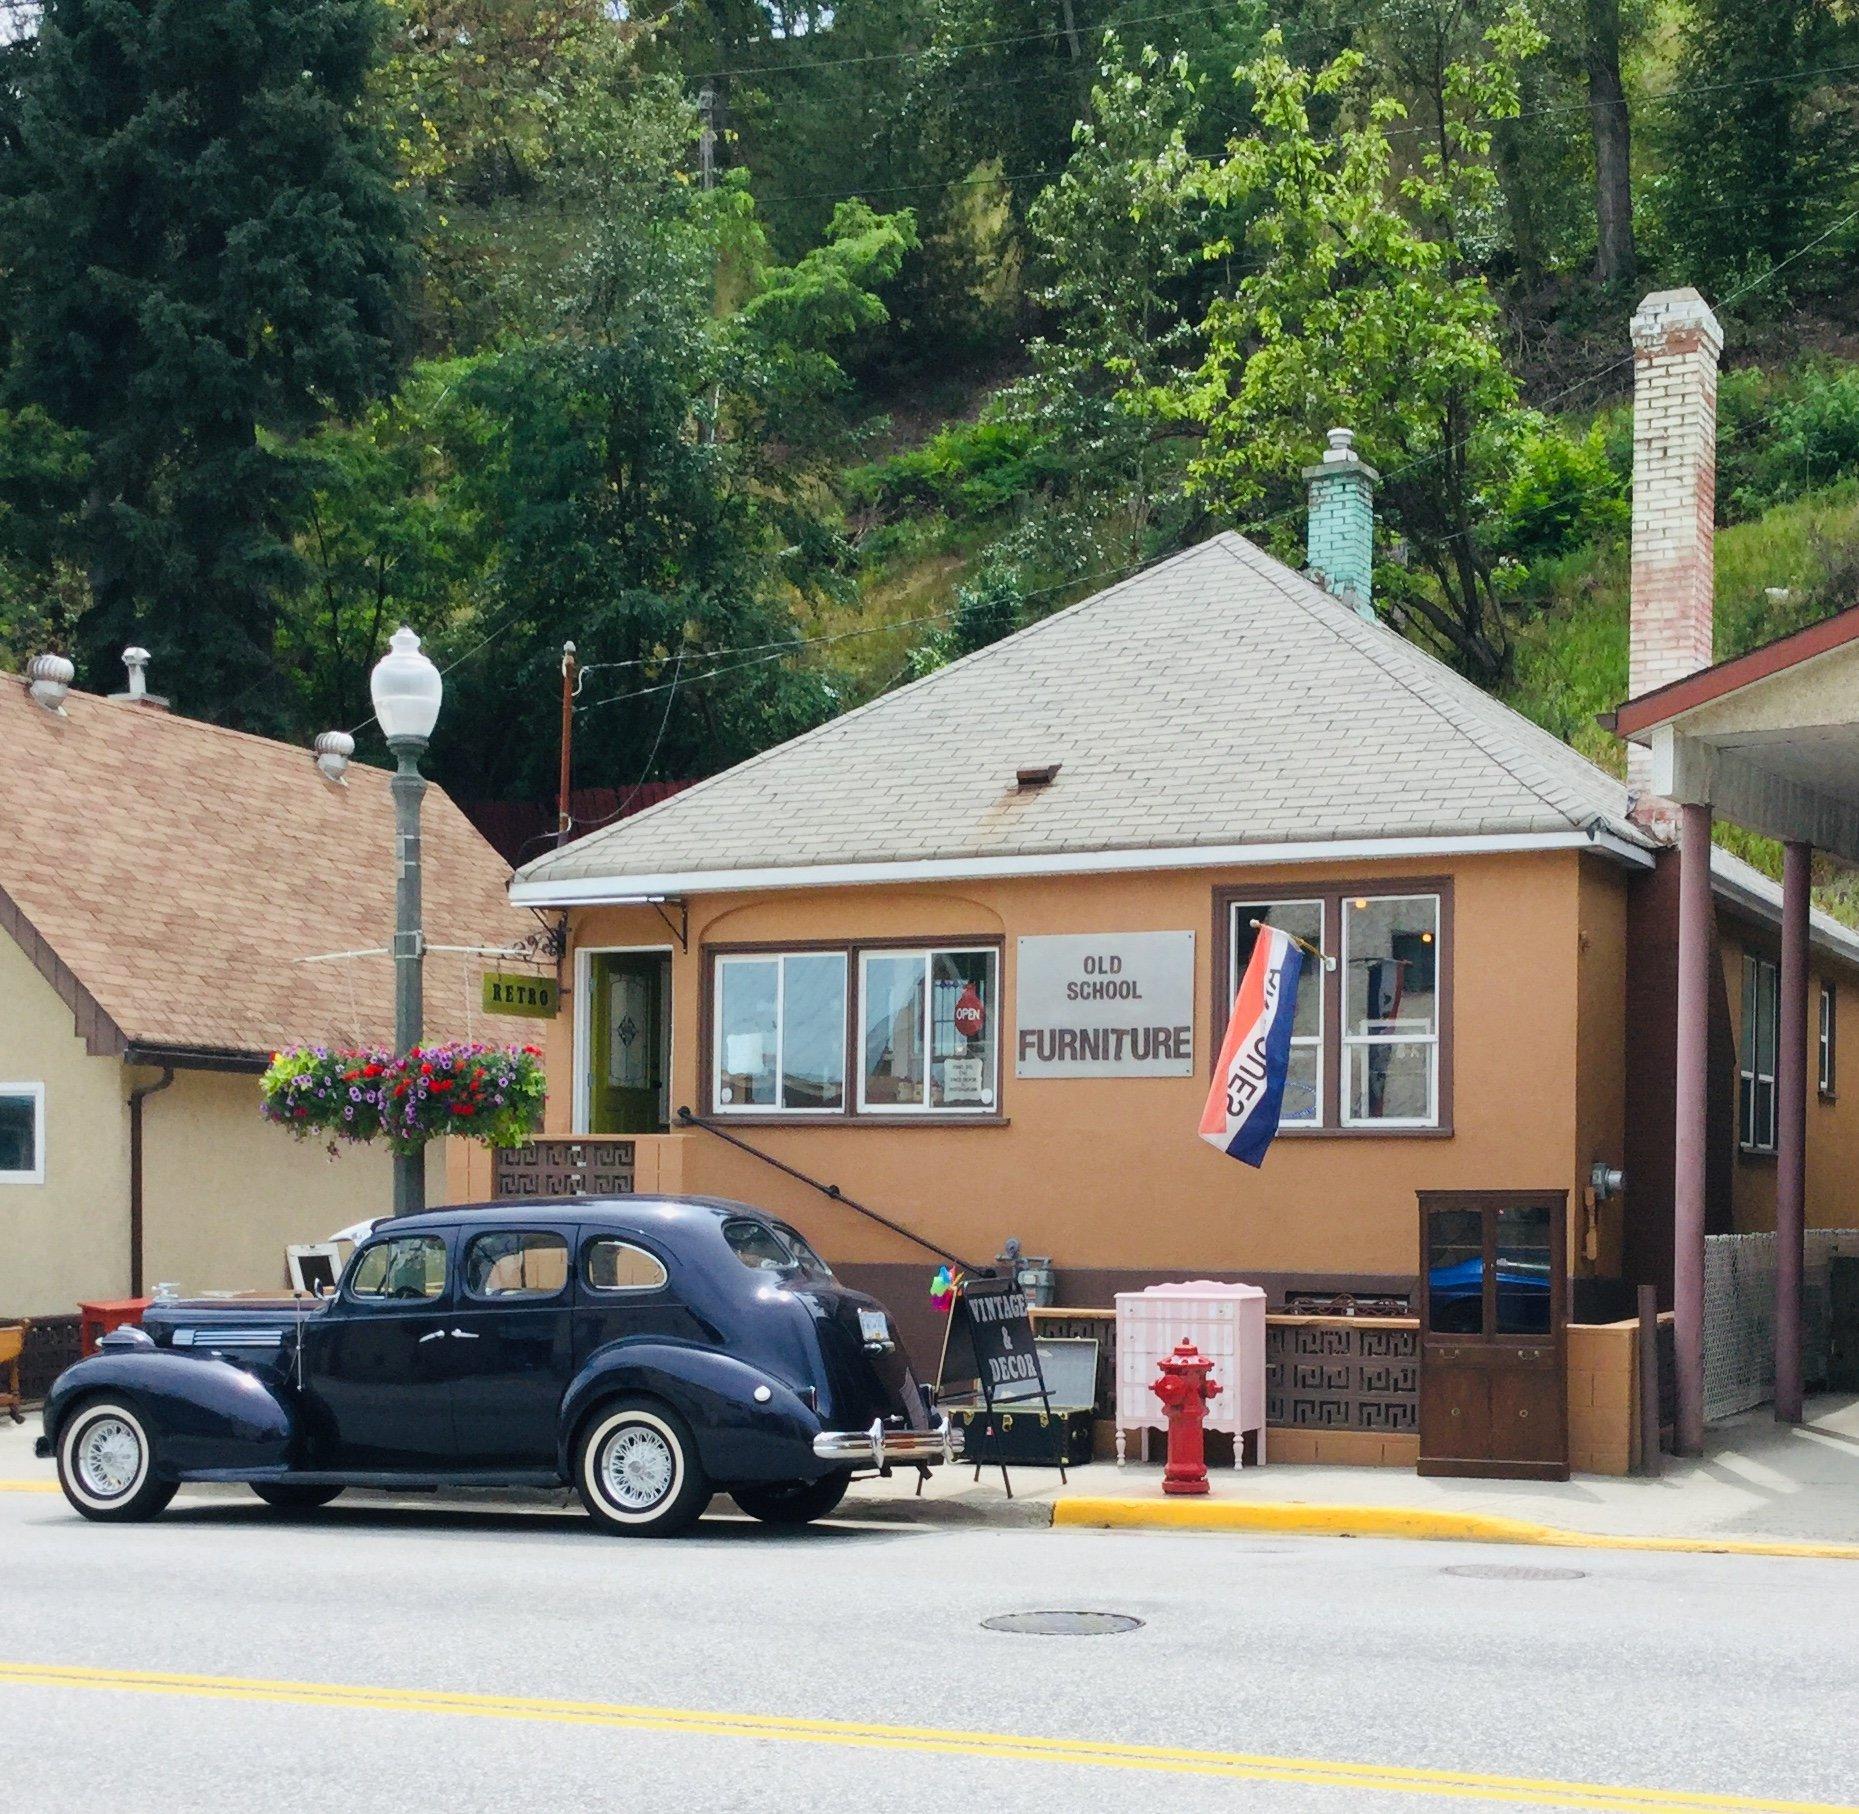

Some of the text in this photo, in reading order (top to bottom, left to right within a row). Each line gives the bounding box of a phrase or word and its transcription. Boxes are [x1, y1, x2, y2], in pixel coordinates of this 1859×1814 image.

[1083, 955, 1122, 975] OLD
[492, 983, 548, 1006] RETRO
[1066, 980, 1142, 1001] SCHOOL
[956, 1007, 980, 1021] OPEN
[1018, 1026, 1191, 1062] FURNITURE
[968, 1293, 1028, 1323] VINTAGE
[1001, 1326, 1014, 1350] &
[988, 1353, 1038, 1383] DECOR
